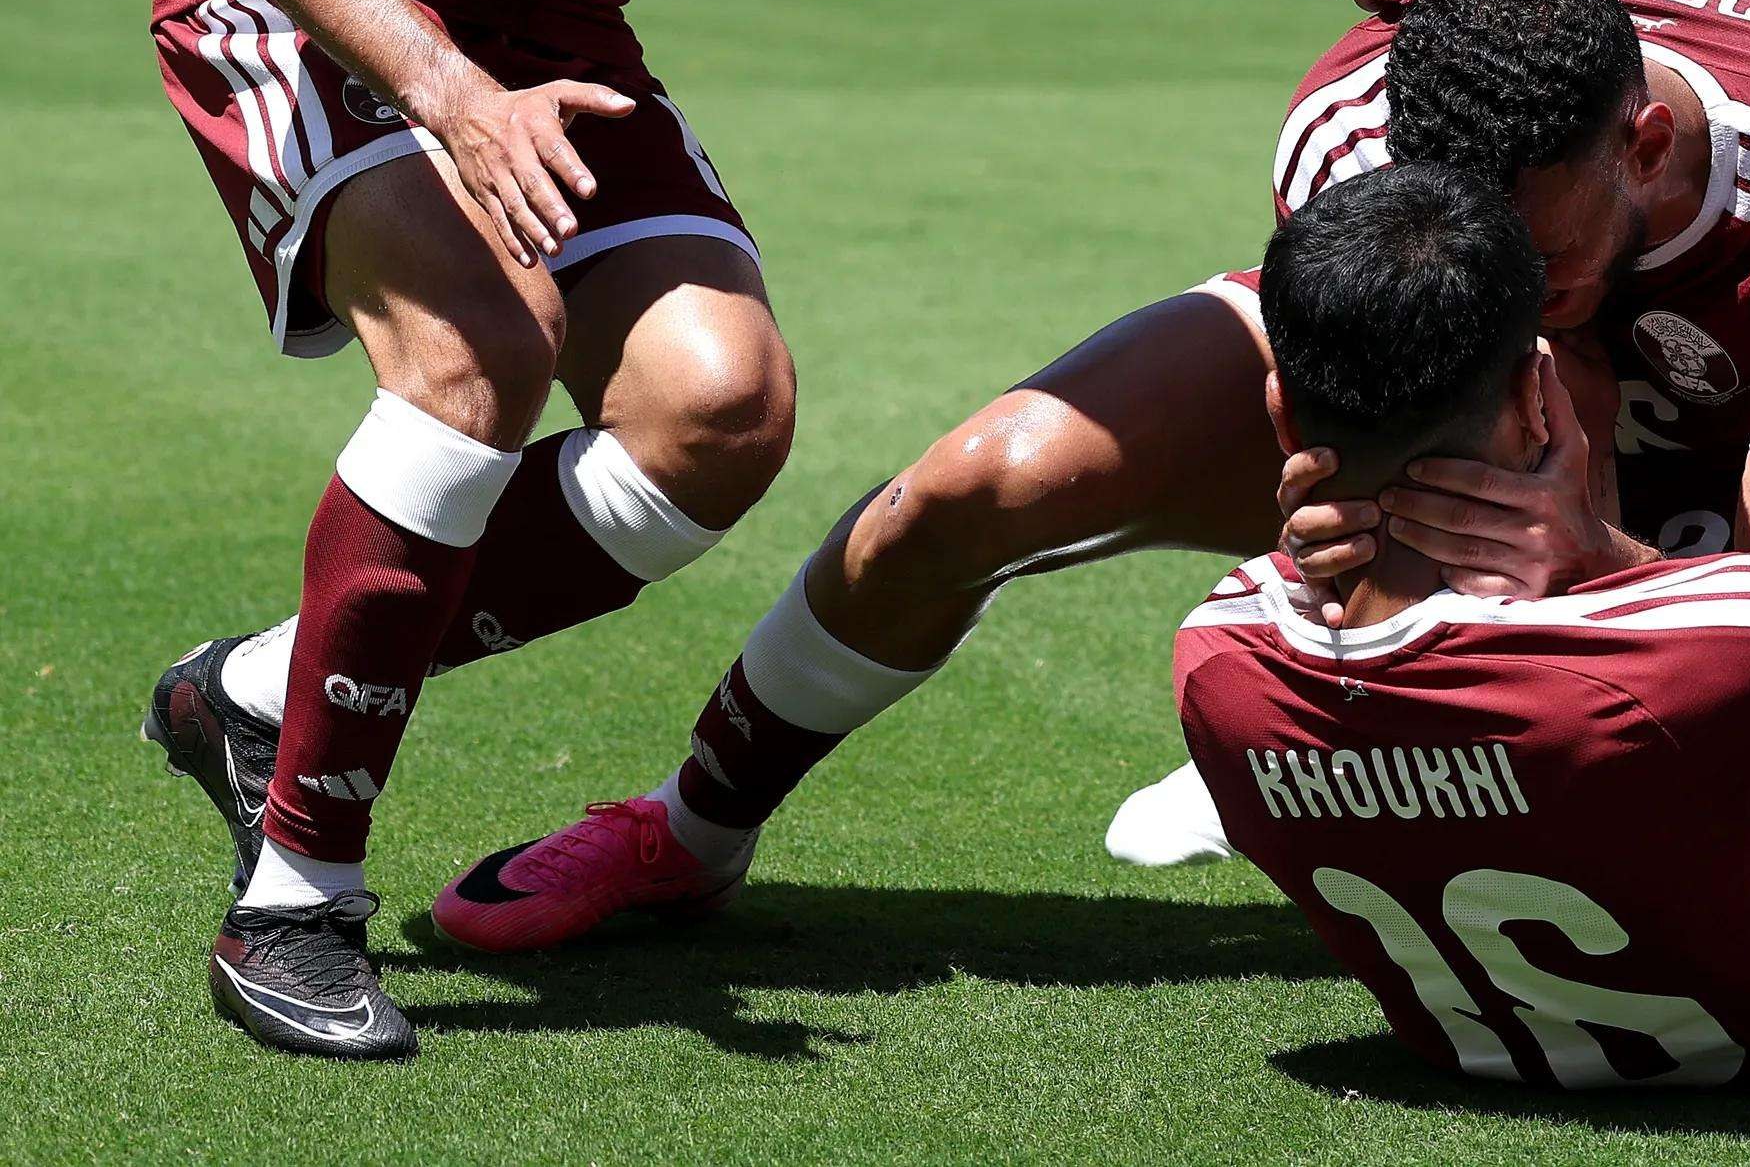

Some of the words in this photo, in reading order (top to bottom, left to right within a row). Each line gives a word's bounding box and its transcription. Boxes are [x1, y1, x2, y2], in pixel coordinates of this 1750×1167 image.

[1668, 370, 1719, 393] QFA
[324, 673, 407, 717] QFA
[1246, 744, 1530, 820] KHOUKHI
[1312, 866, 1746, 1090] 16
